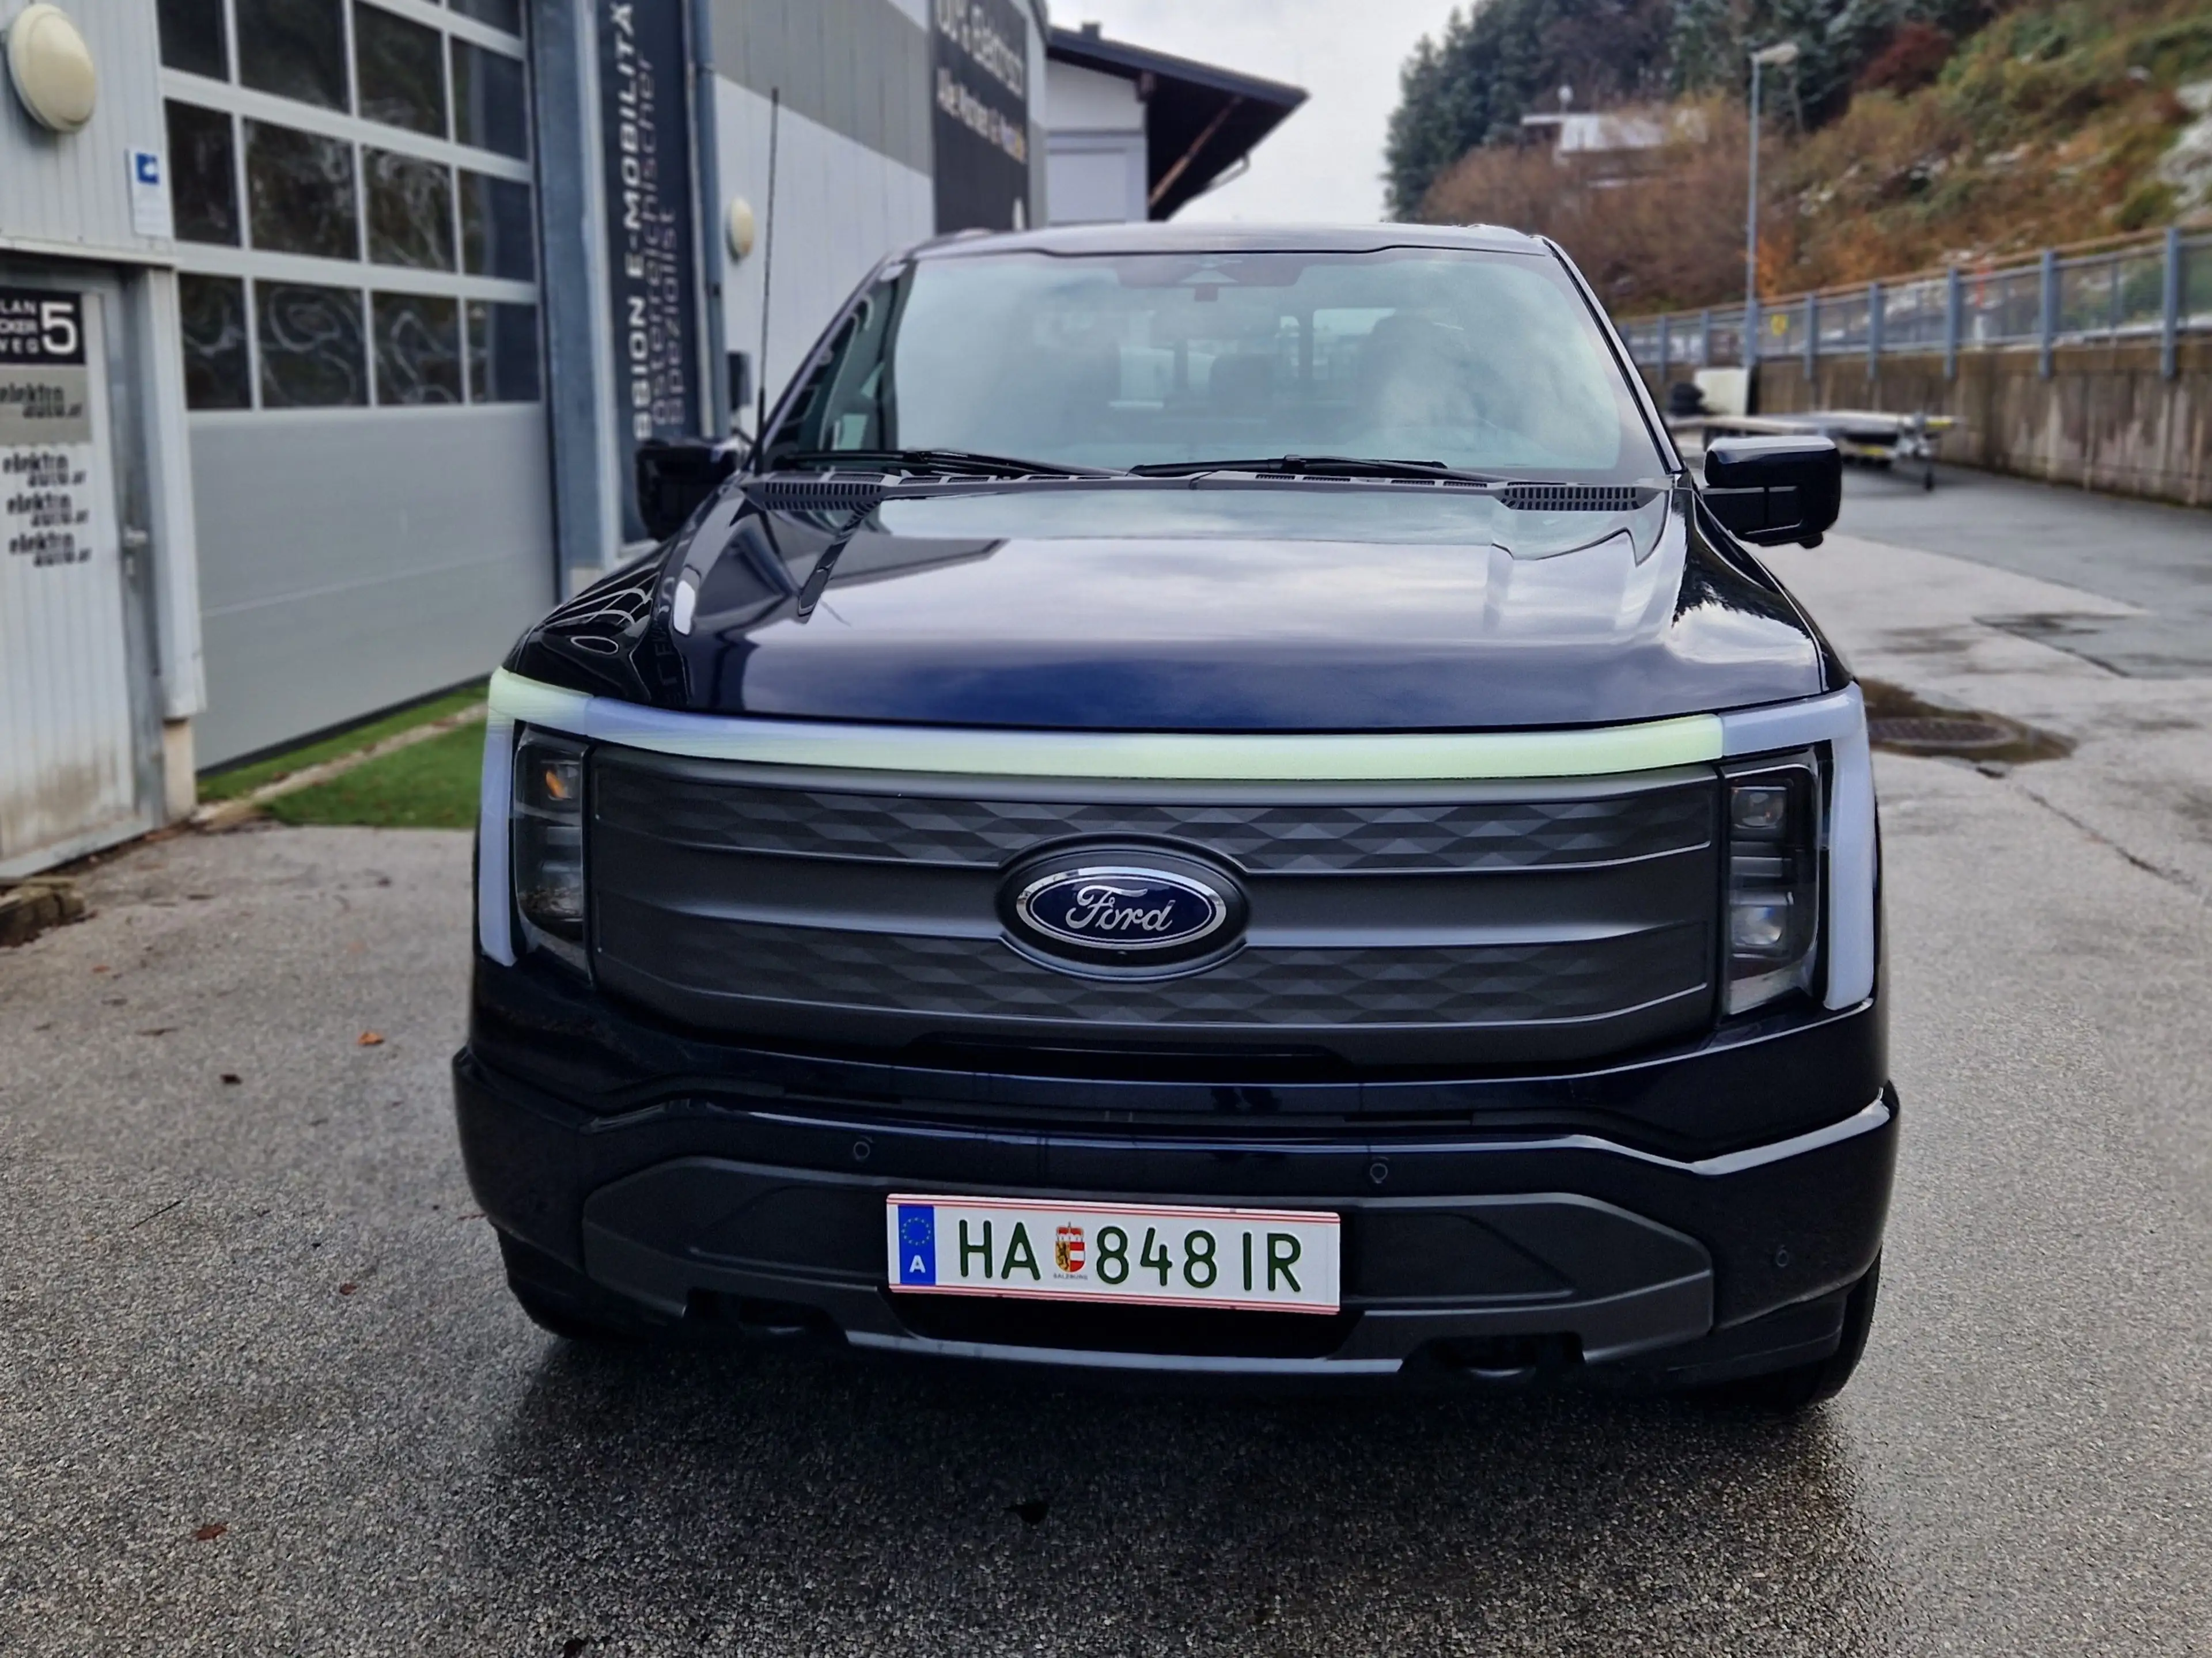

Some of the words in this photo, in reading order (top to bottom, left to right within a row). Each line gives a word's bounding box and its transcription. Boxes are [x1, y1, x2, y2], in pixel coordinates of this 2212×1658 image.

[40, 300, 79, 356] 5
[1065, 884, 1176, 932] Ford
[909, 1255, 926, 1273] A
[959, 1219, 1041, 1281] HA
[1096, 1226, 1217, 1289] 848
[1241, 1231, 1302, 1293] IR
